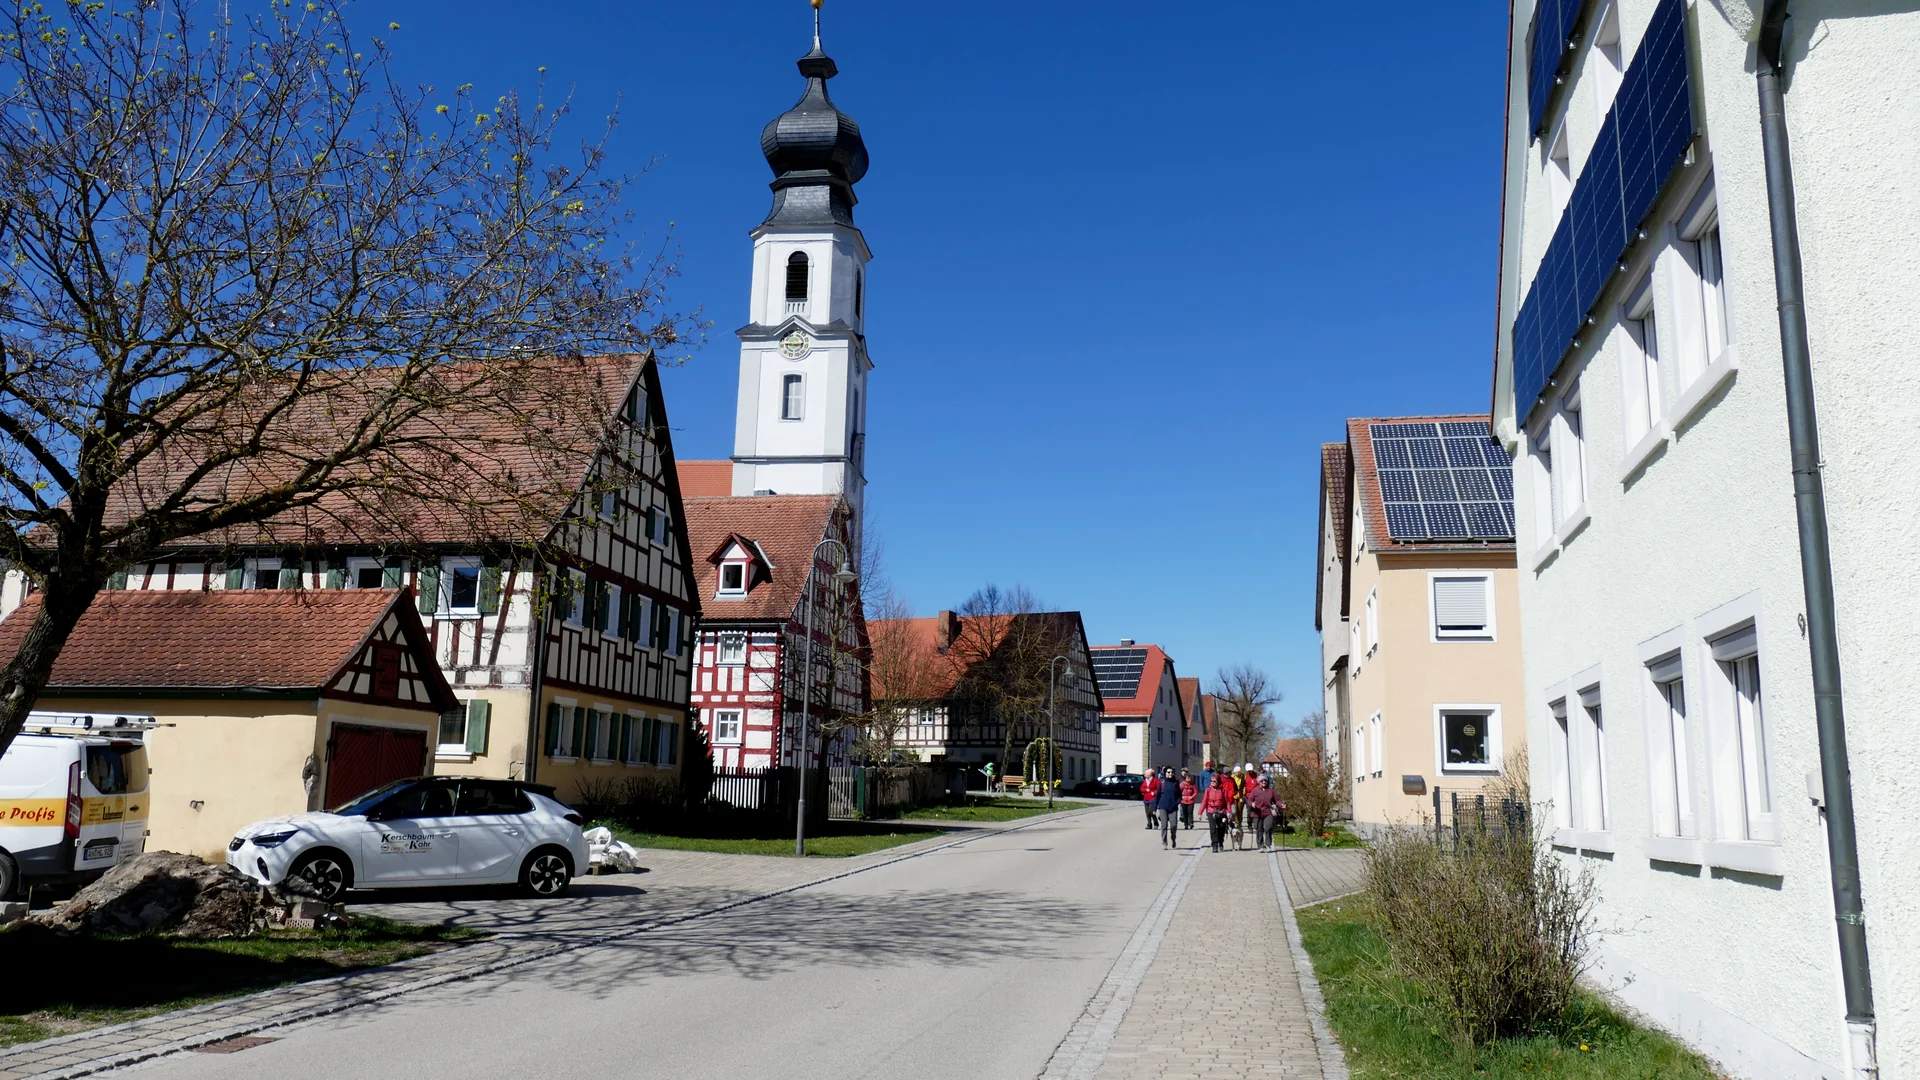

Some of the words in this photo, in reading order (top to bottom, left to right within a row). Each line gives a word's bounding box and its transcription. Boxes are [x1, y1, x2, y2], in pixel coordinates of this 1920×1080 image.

[10, 807, 55, 822] Profis
[381, 833, 434, 842] Kerschbaum
[409, 840, 431, 849] Kahr
